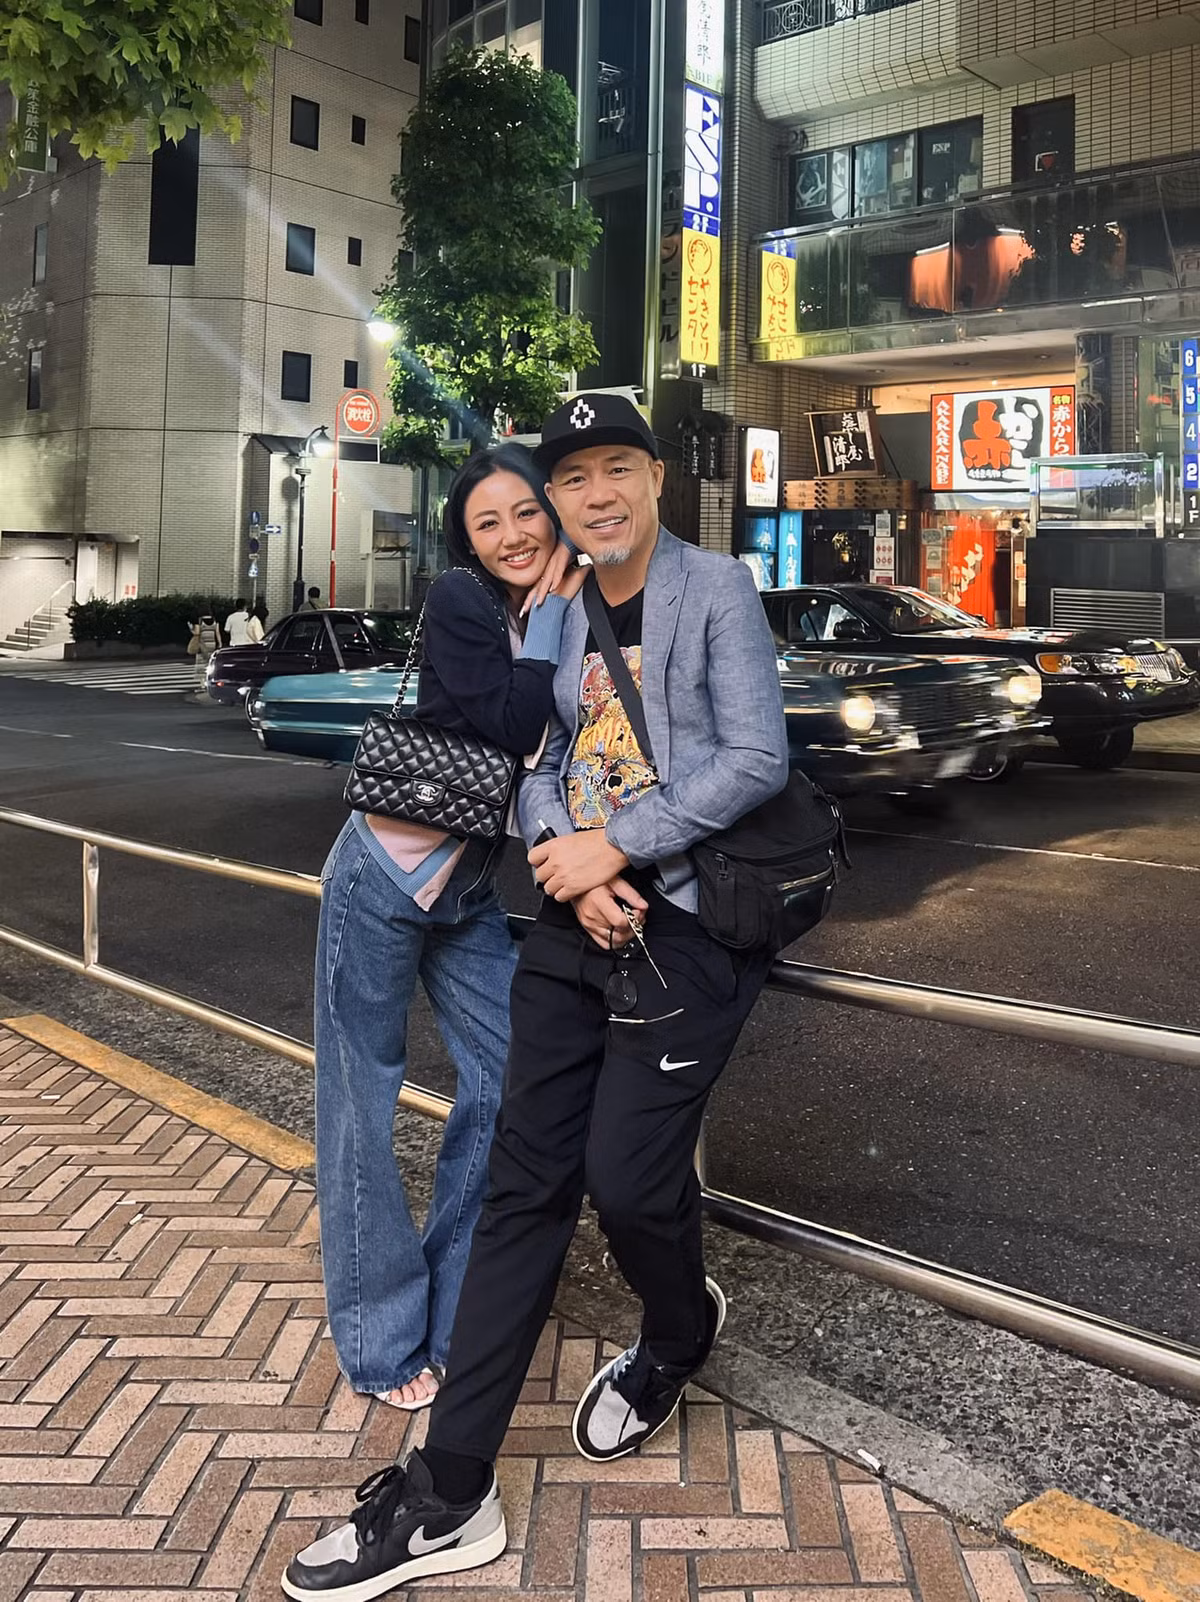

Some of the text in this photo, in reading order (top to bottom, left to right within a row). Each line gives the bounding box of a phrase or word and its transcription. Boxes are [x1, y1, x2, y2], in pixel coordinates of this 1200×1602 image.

[692, 213, 709, 233] 2F
[687, 275, 699, 357] センター
[700, 277, 711, 361] やきとり
[1184, 350, 1194, 367] 6
[691, 362, 707, 379] 1F
[1185, 384, 1196, 405] 5
[347, 407, 373, 422] 消火栓
[1052, 405, 1072, 457] 赤から
[1186, 423, 1197, 441] 4
[1186, 463, 1198, 481] 2
